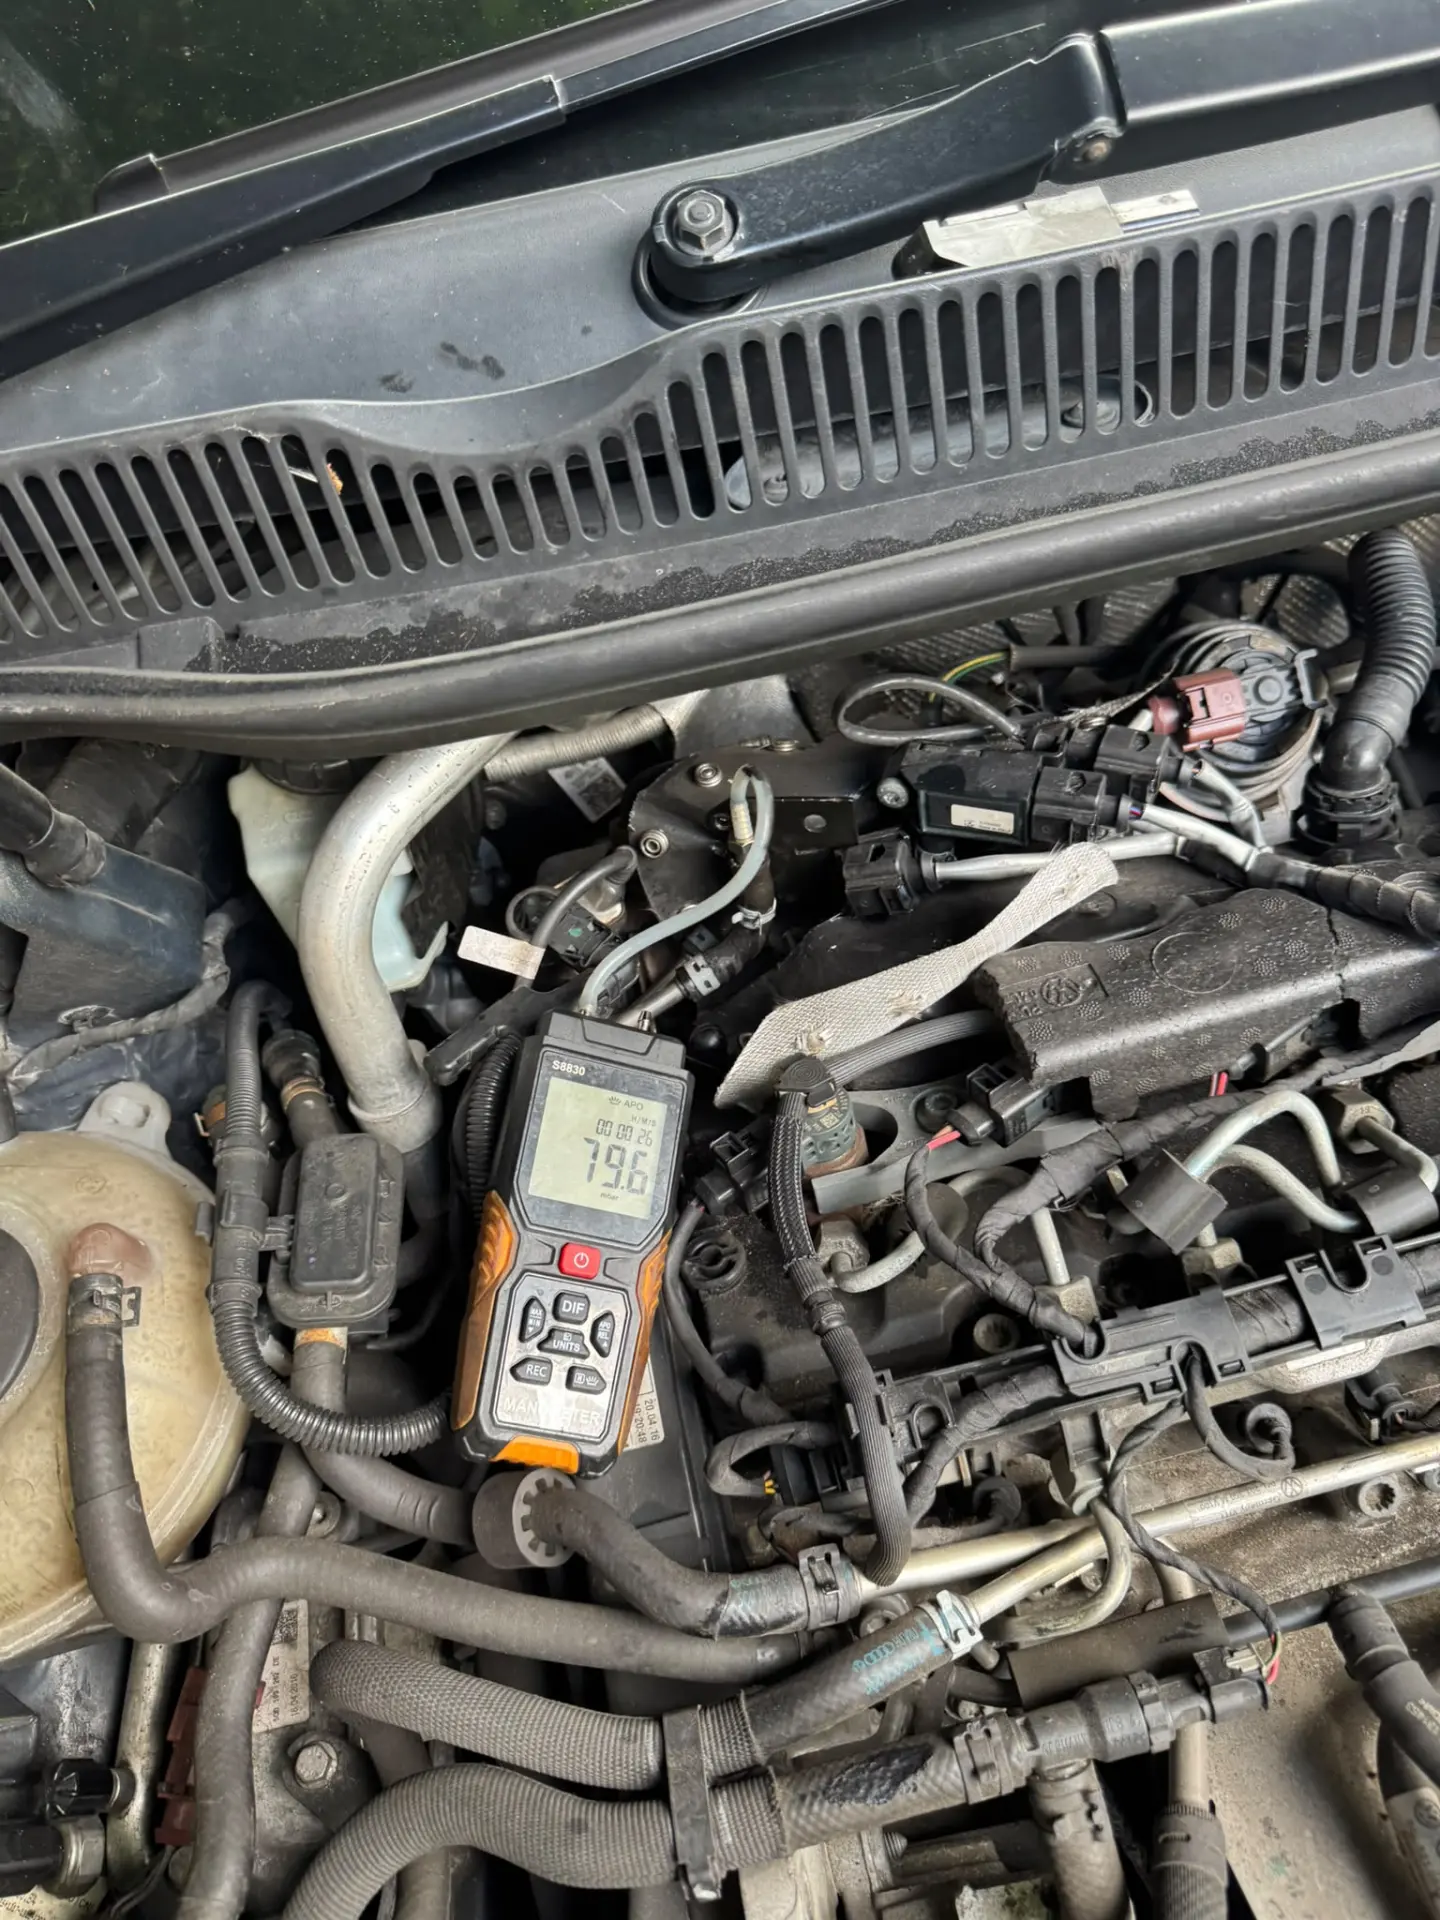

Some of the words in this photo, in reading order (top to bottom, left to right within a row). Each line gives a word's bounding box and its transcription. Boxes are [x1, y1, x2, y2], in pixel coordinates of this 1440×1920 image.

[552, 1060, 585, 1076] S8830
[623, 1099, 645, 1111] APO
[637, 1128, 653, 1147] 26
[583, 1137, 649, 1195] 79.6
[600, 1192, 620, 1201] mbar
[562, 1299, 586, 1314] DIF
[552, 1339, 581, 1352] UNITS
[526, 1364, 548, 1378] REC
